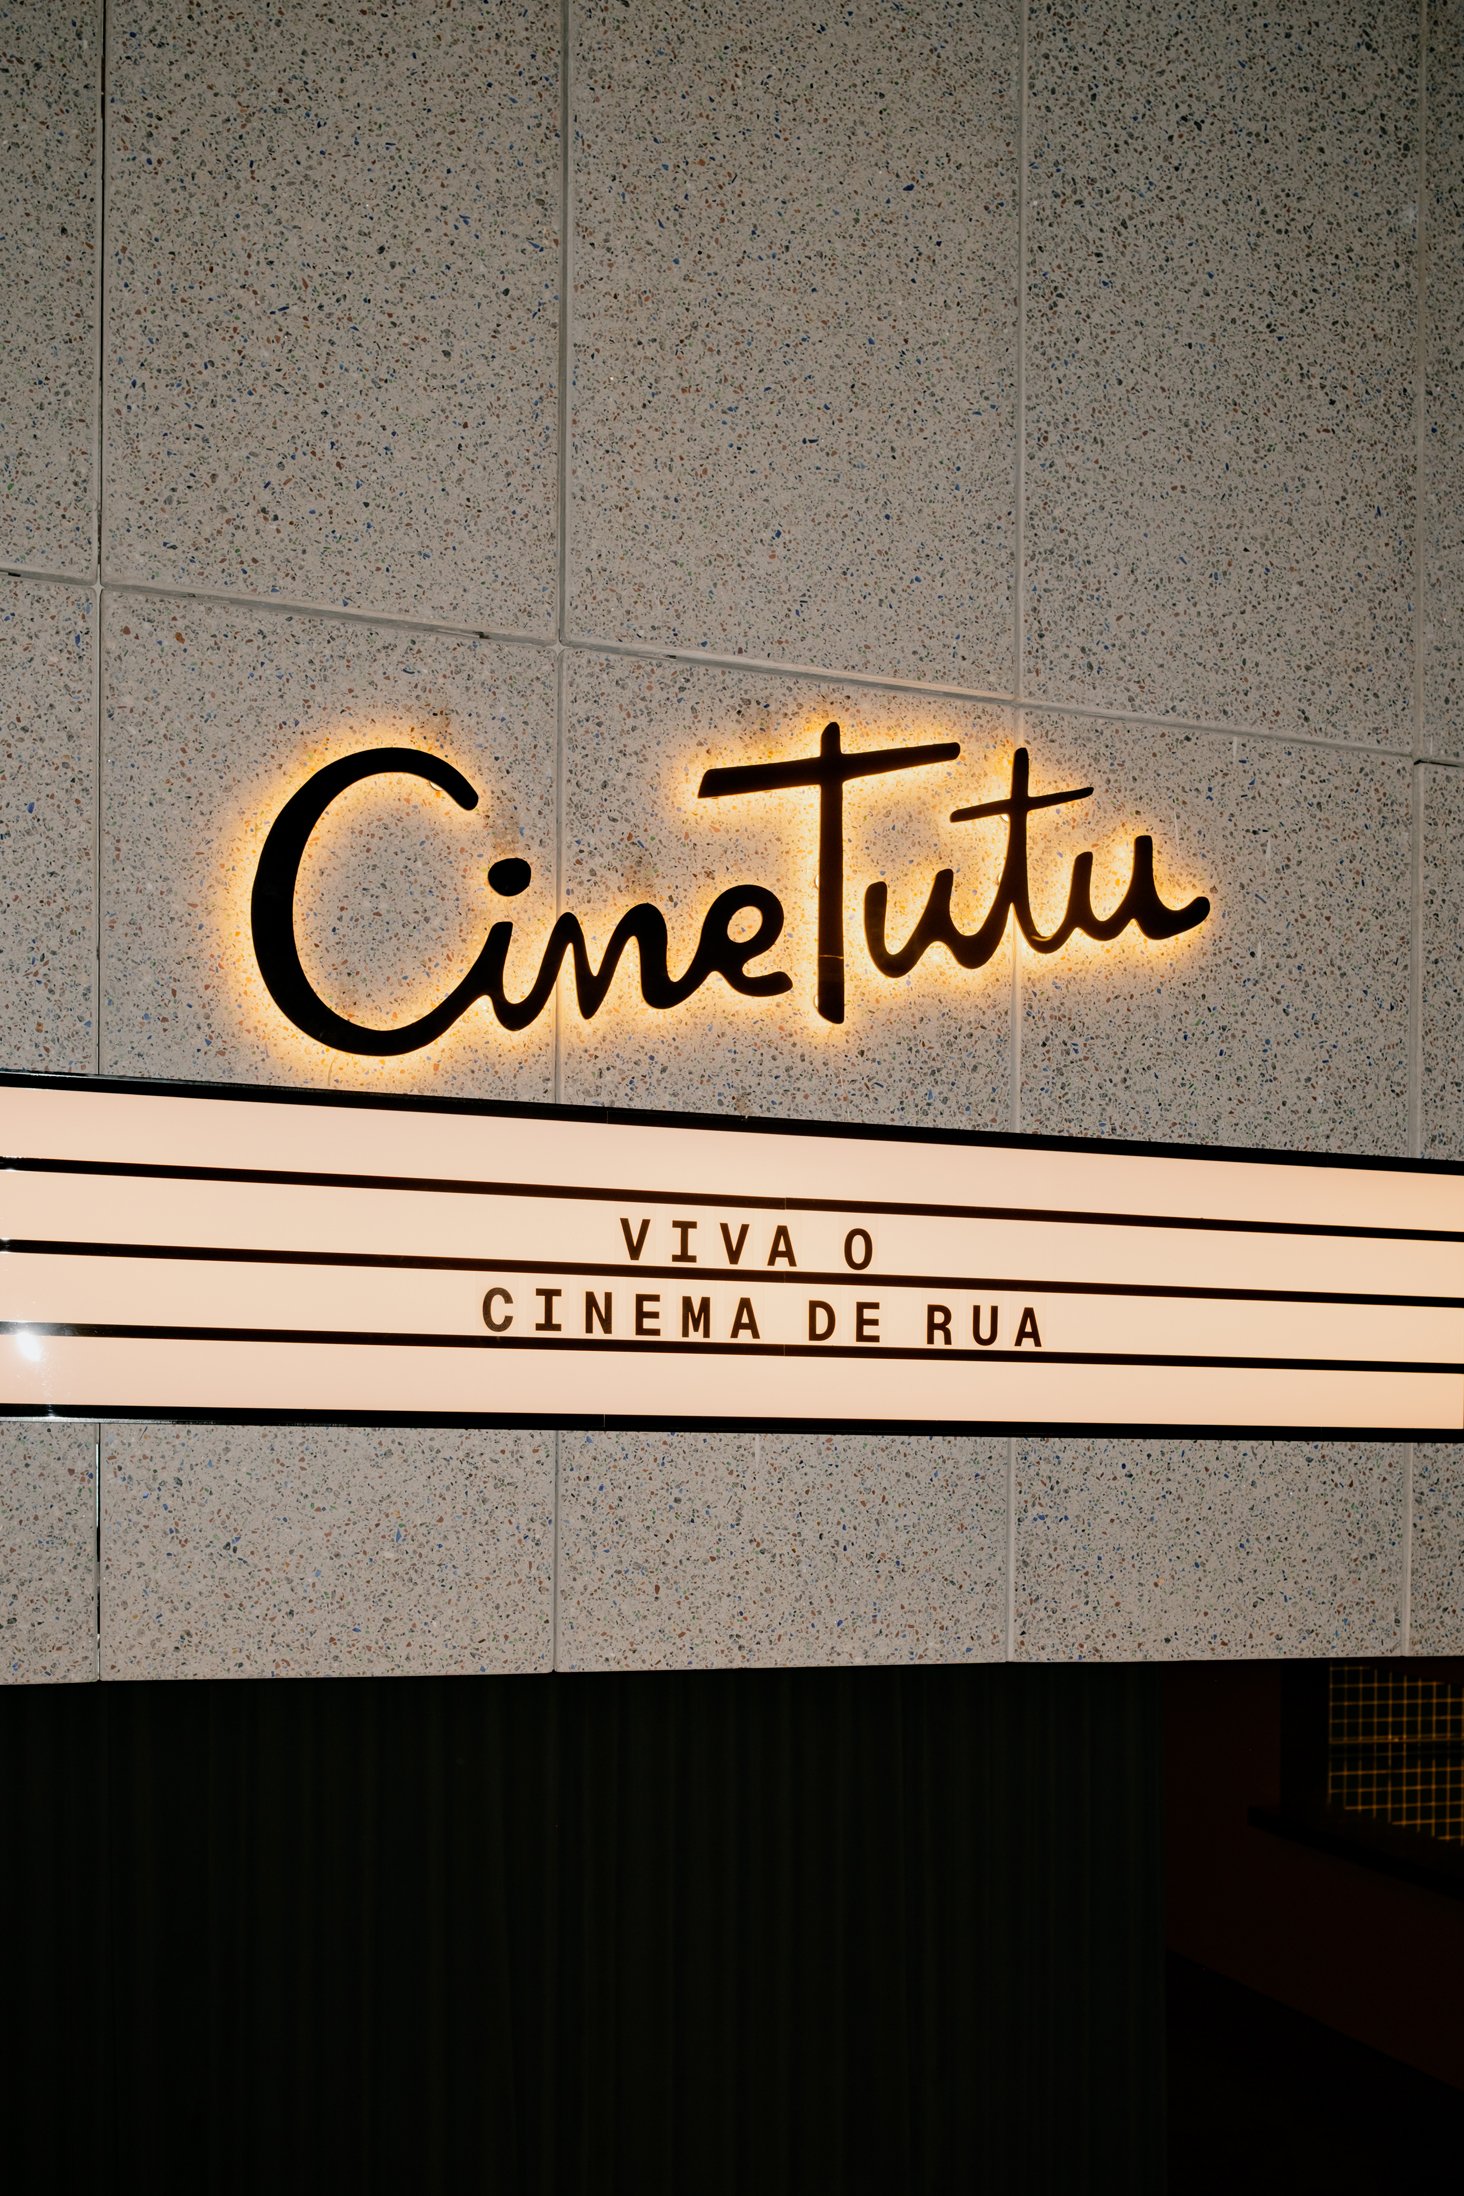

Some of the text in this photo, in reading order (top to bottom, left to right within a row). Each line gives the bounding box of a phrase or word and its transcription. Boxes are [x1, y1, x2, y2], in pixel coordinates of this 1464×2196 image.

[619, 1217, 874, 1271] VIVA O
[481, 1286, 1043, 1349] CINEMA DE RUA
